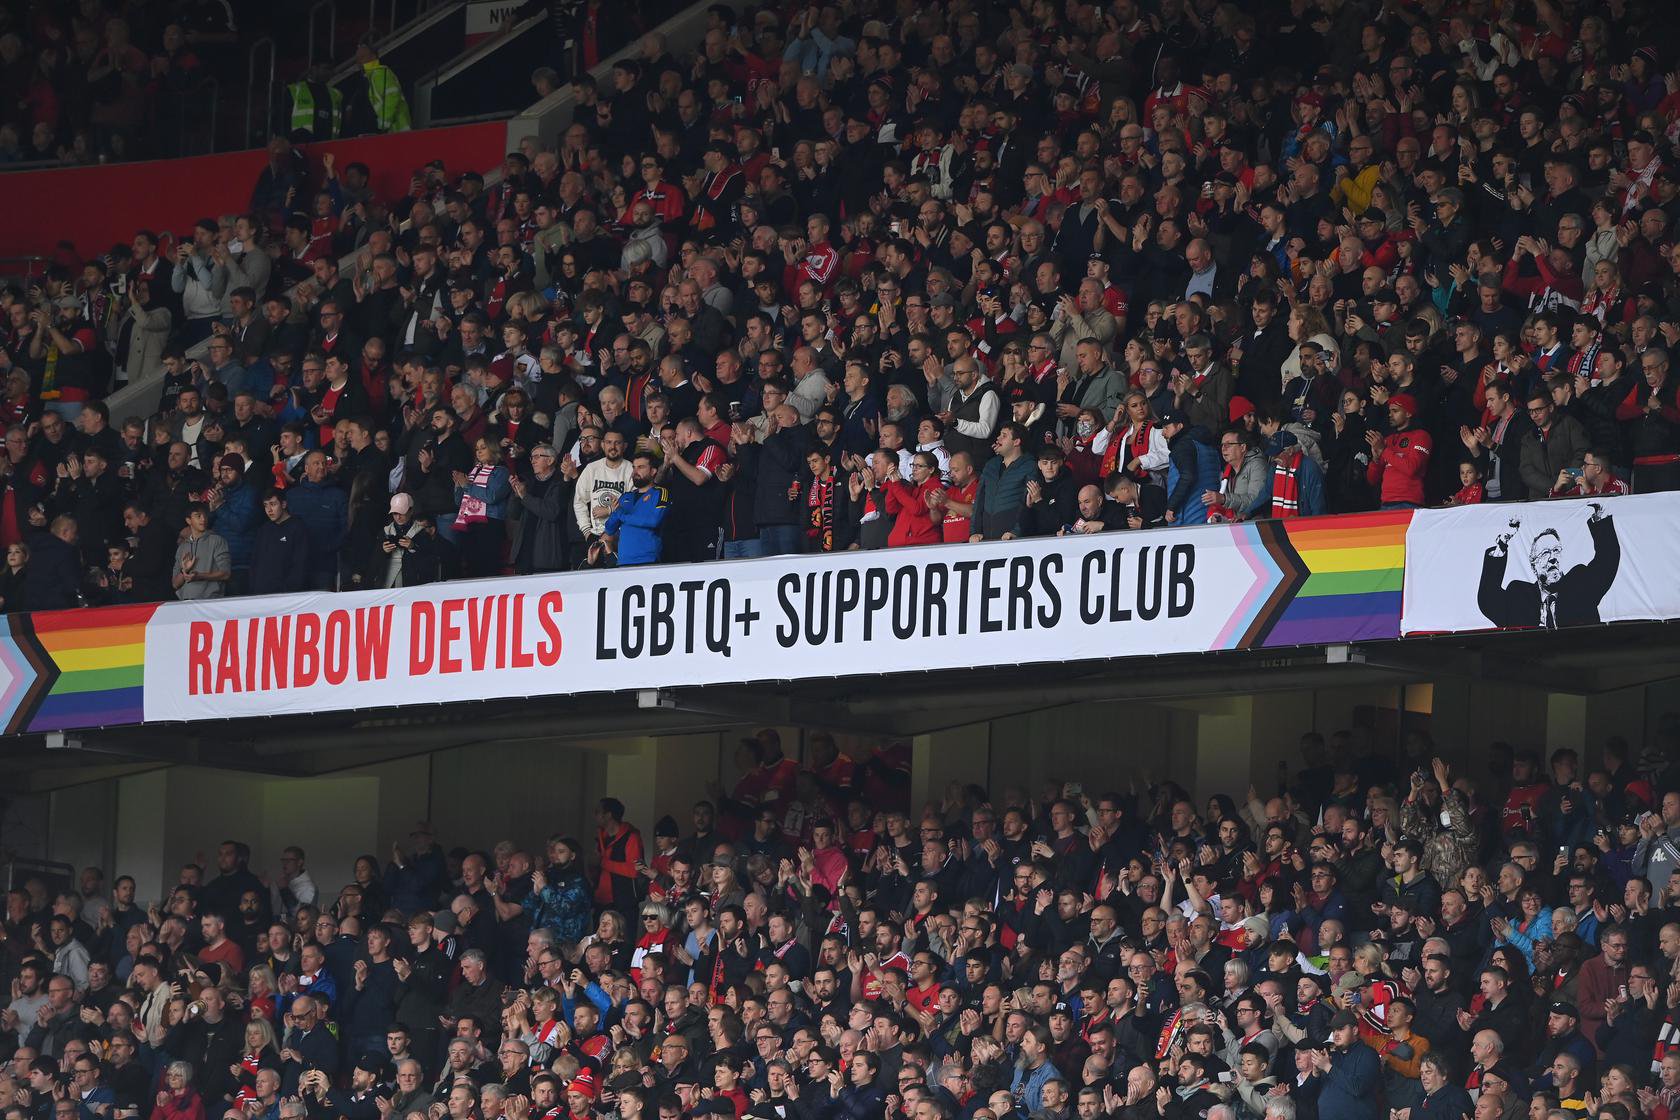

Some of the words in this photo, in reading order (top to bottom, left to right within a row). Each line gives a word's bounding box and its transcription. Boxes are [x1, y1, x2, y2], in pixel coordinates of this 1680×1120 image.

[592, 479, 625, 493] ADIDAS
[188, 603, 394, 696] RAINBOW
[409, 590, 564, 677] DEVILS
[595, 578, 760, 660] LGBTQ+
[776, 555, 1064, 648] SUPPORTERS
[1079, 543, 1196, 625] CLUB
